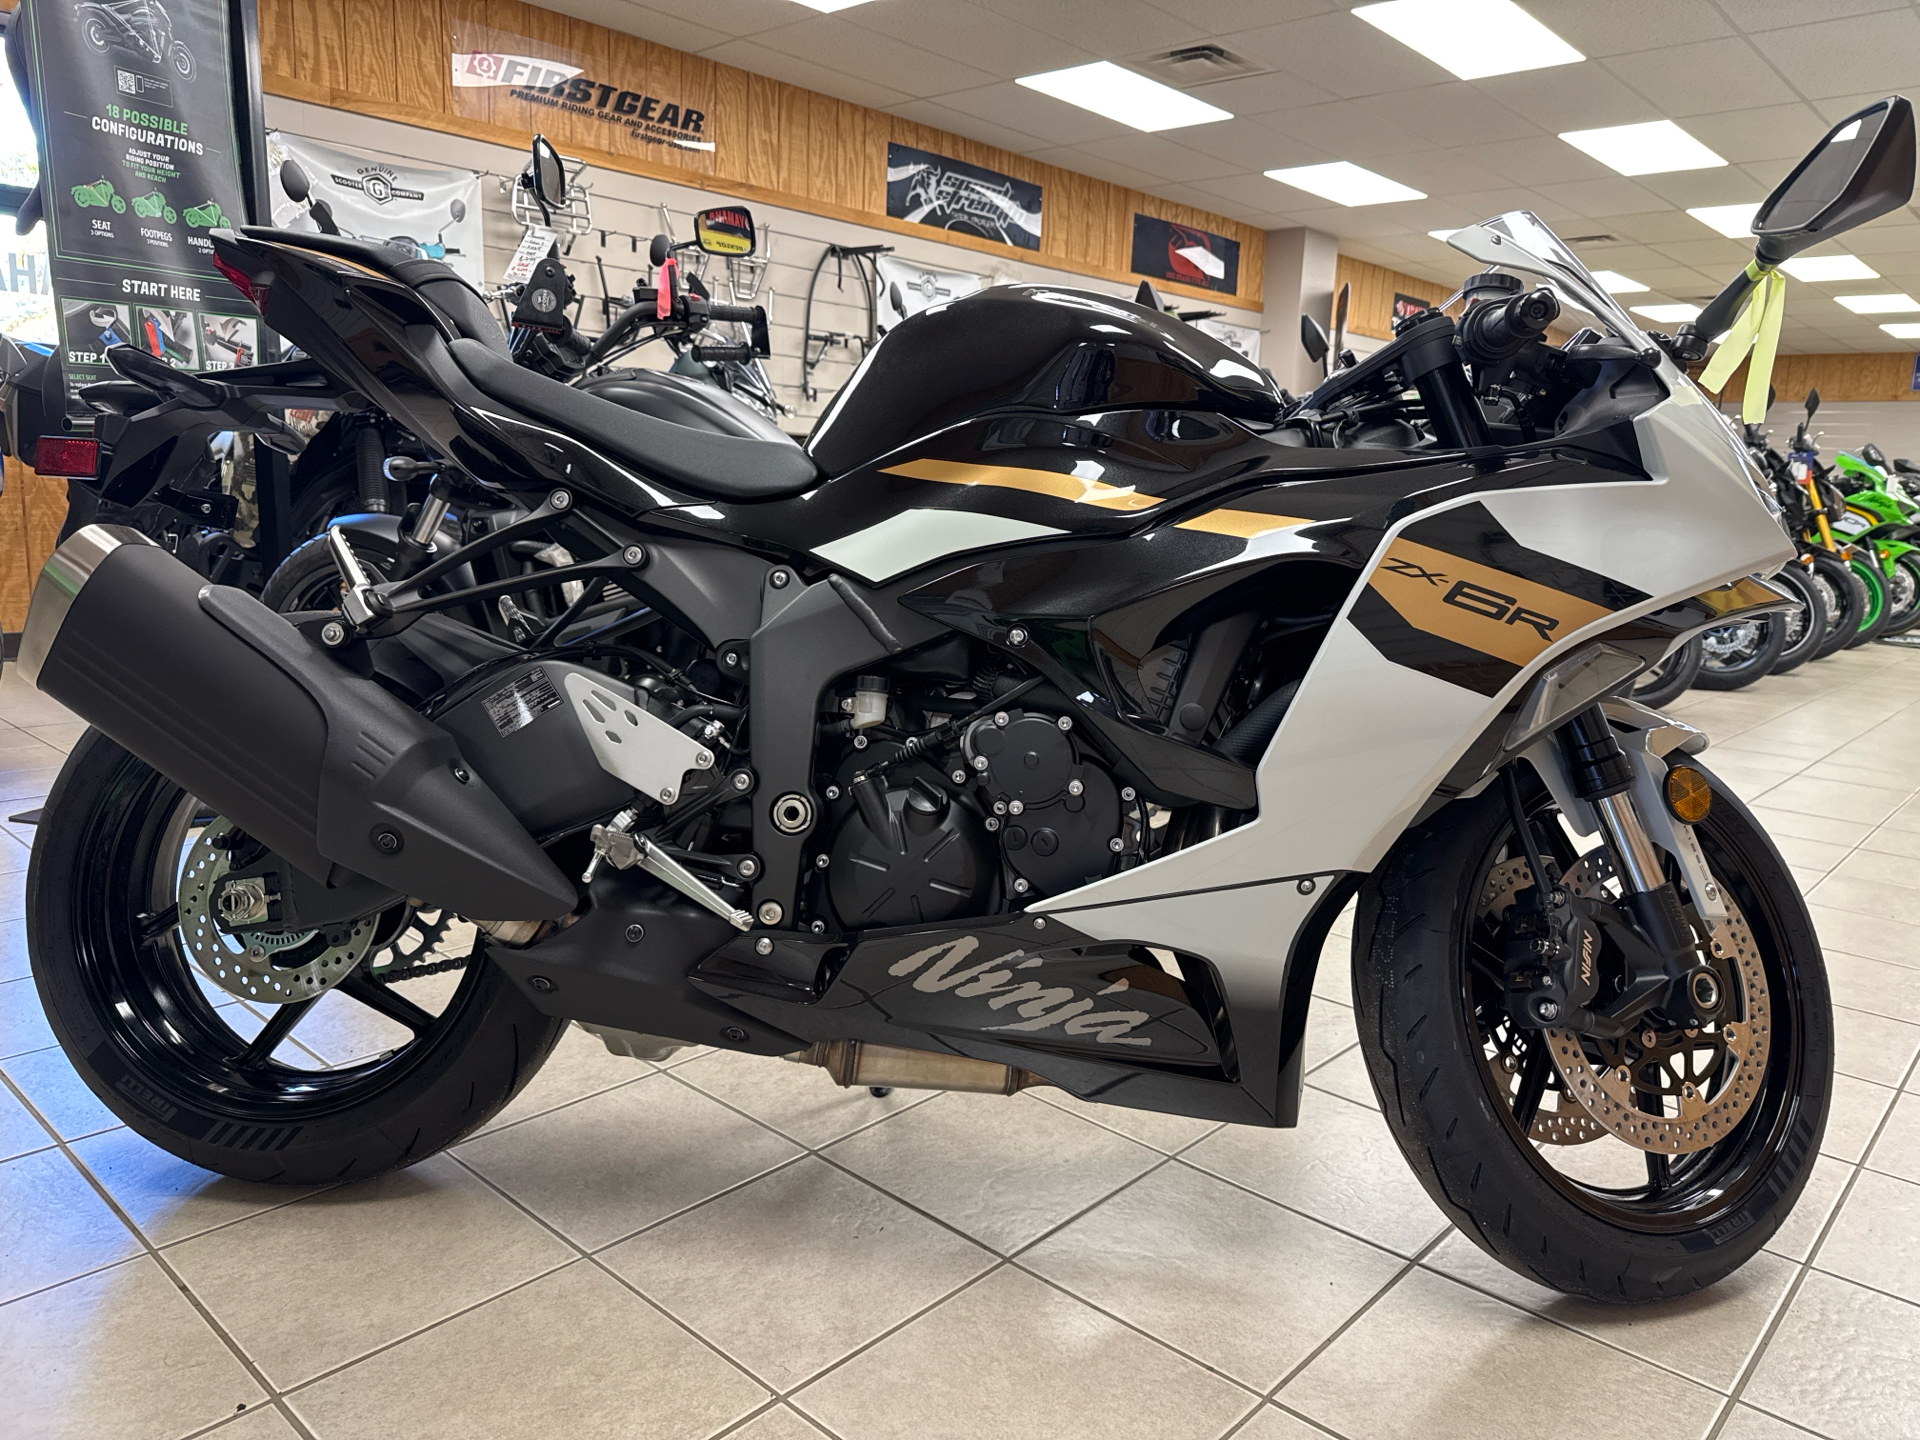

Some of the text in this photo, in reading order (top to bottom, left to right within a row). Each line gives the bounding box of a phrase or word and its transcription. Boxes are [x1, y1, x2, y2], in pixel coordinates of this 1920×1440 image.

[501, 60, 705, 133] FIRSTGEAR
[105, 103, 188, 136] 18 POSSIBLE
[510, 89, 702, 142] PREMIUM RIDING GEAR AND ACCESSORIES
[91, 116, 204, 156] CONFIGURATIONS
[125, 153, 175, 171] RIDING POSITION
[128, 147, 170, 163] ADJUST YOUR
[130, 161, 140, 169] FIT
[140, 164, 156, 174] YOUR
[156, 168, 181, 179] HEIGHT
[134, 170, 167, 183] AND REACH
[356, 165, 398, 182] GENUINE
[334, 177, 362, 189] SCOOTER
[369, 179, 385, 199] G
[391, 189, 423, 199] COMPANY
[91, 219, 112, 231] SEAT
[94, 230, 115, 239] OPTIONS
[140, 228, 173, 242] FOOTPEGS
[187, 236, 215, 248] HANDL
[121, 279, 201, 301] START HERE
[69, 351, 106, 364] STEP 1
[206, 361, 228, 370] STEP
[1580, 929, 1593, 987] NISSIN
[888, 935, 1152, 1046] Ninja
[115, 1074, 179, 1122] PIRELLI
